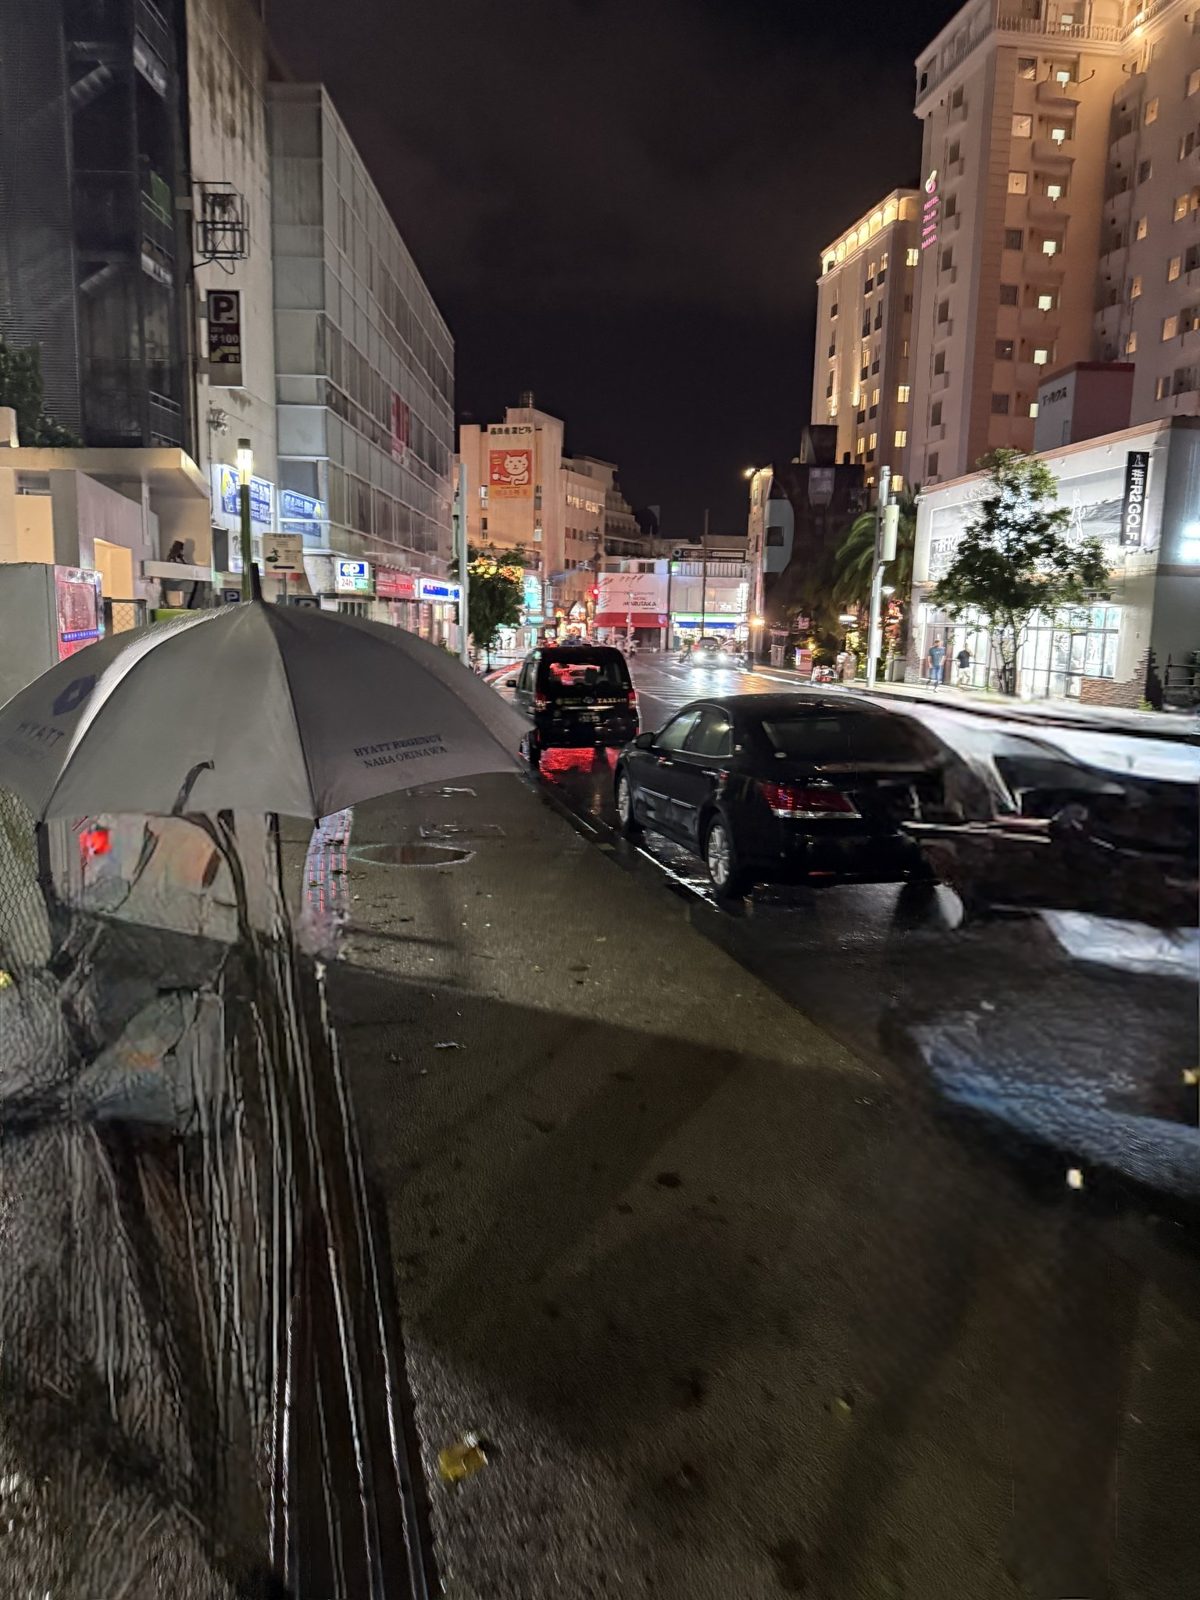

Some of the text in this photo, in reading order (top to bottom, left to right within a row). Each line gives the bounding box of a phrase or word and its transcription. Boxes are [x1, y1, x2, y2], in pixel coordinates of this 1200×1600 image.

[213, 295, 234, 321] P
[226, 592, 239, 602] P
[353, 735, 442, 757] HYATT REGENCY
[364, 745, 448, 768] NAHA OKINAWA
